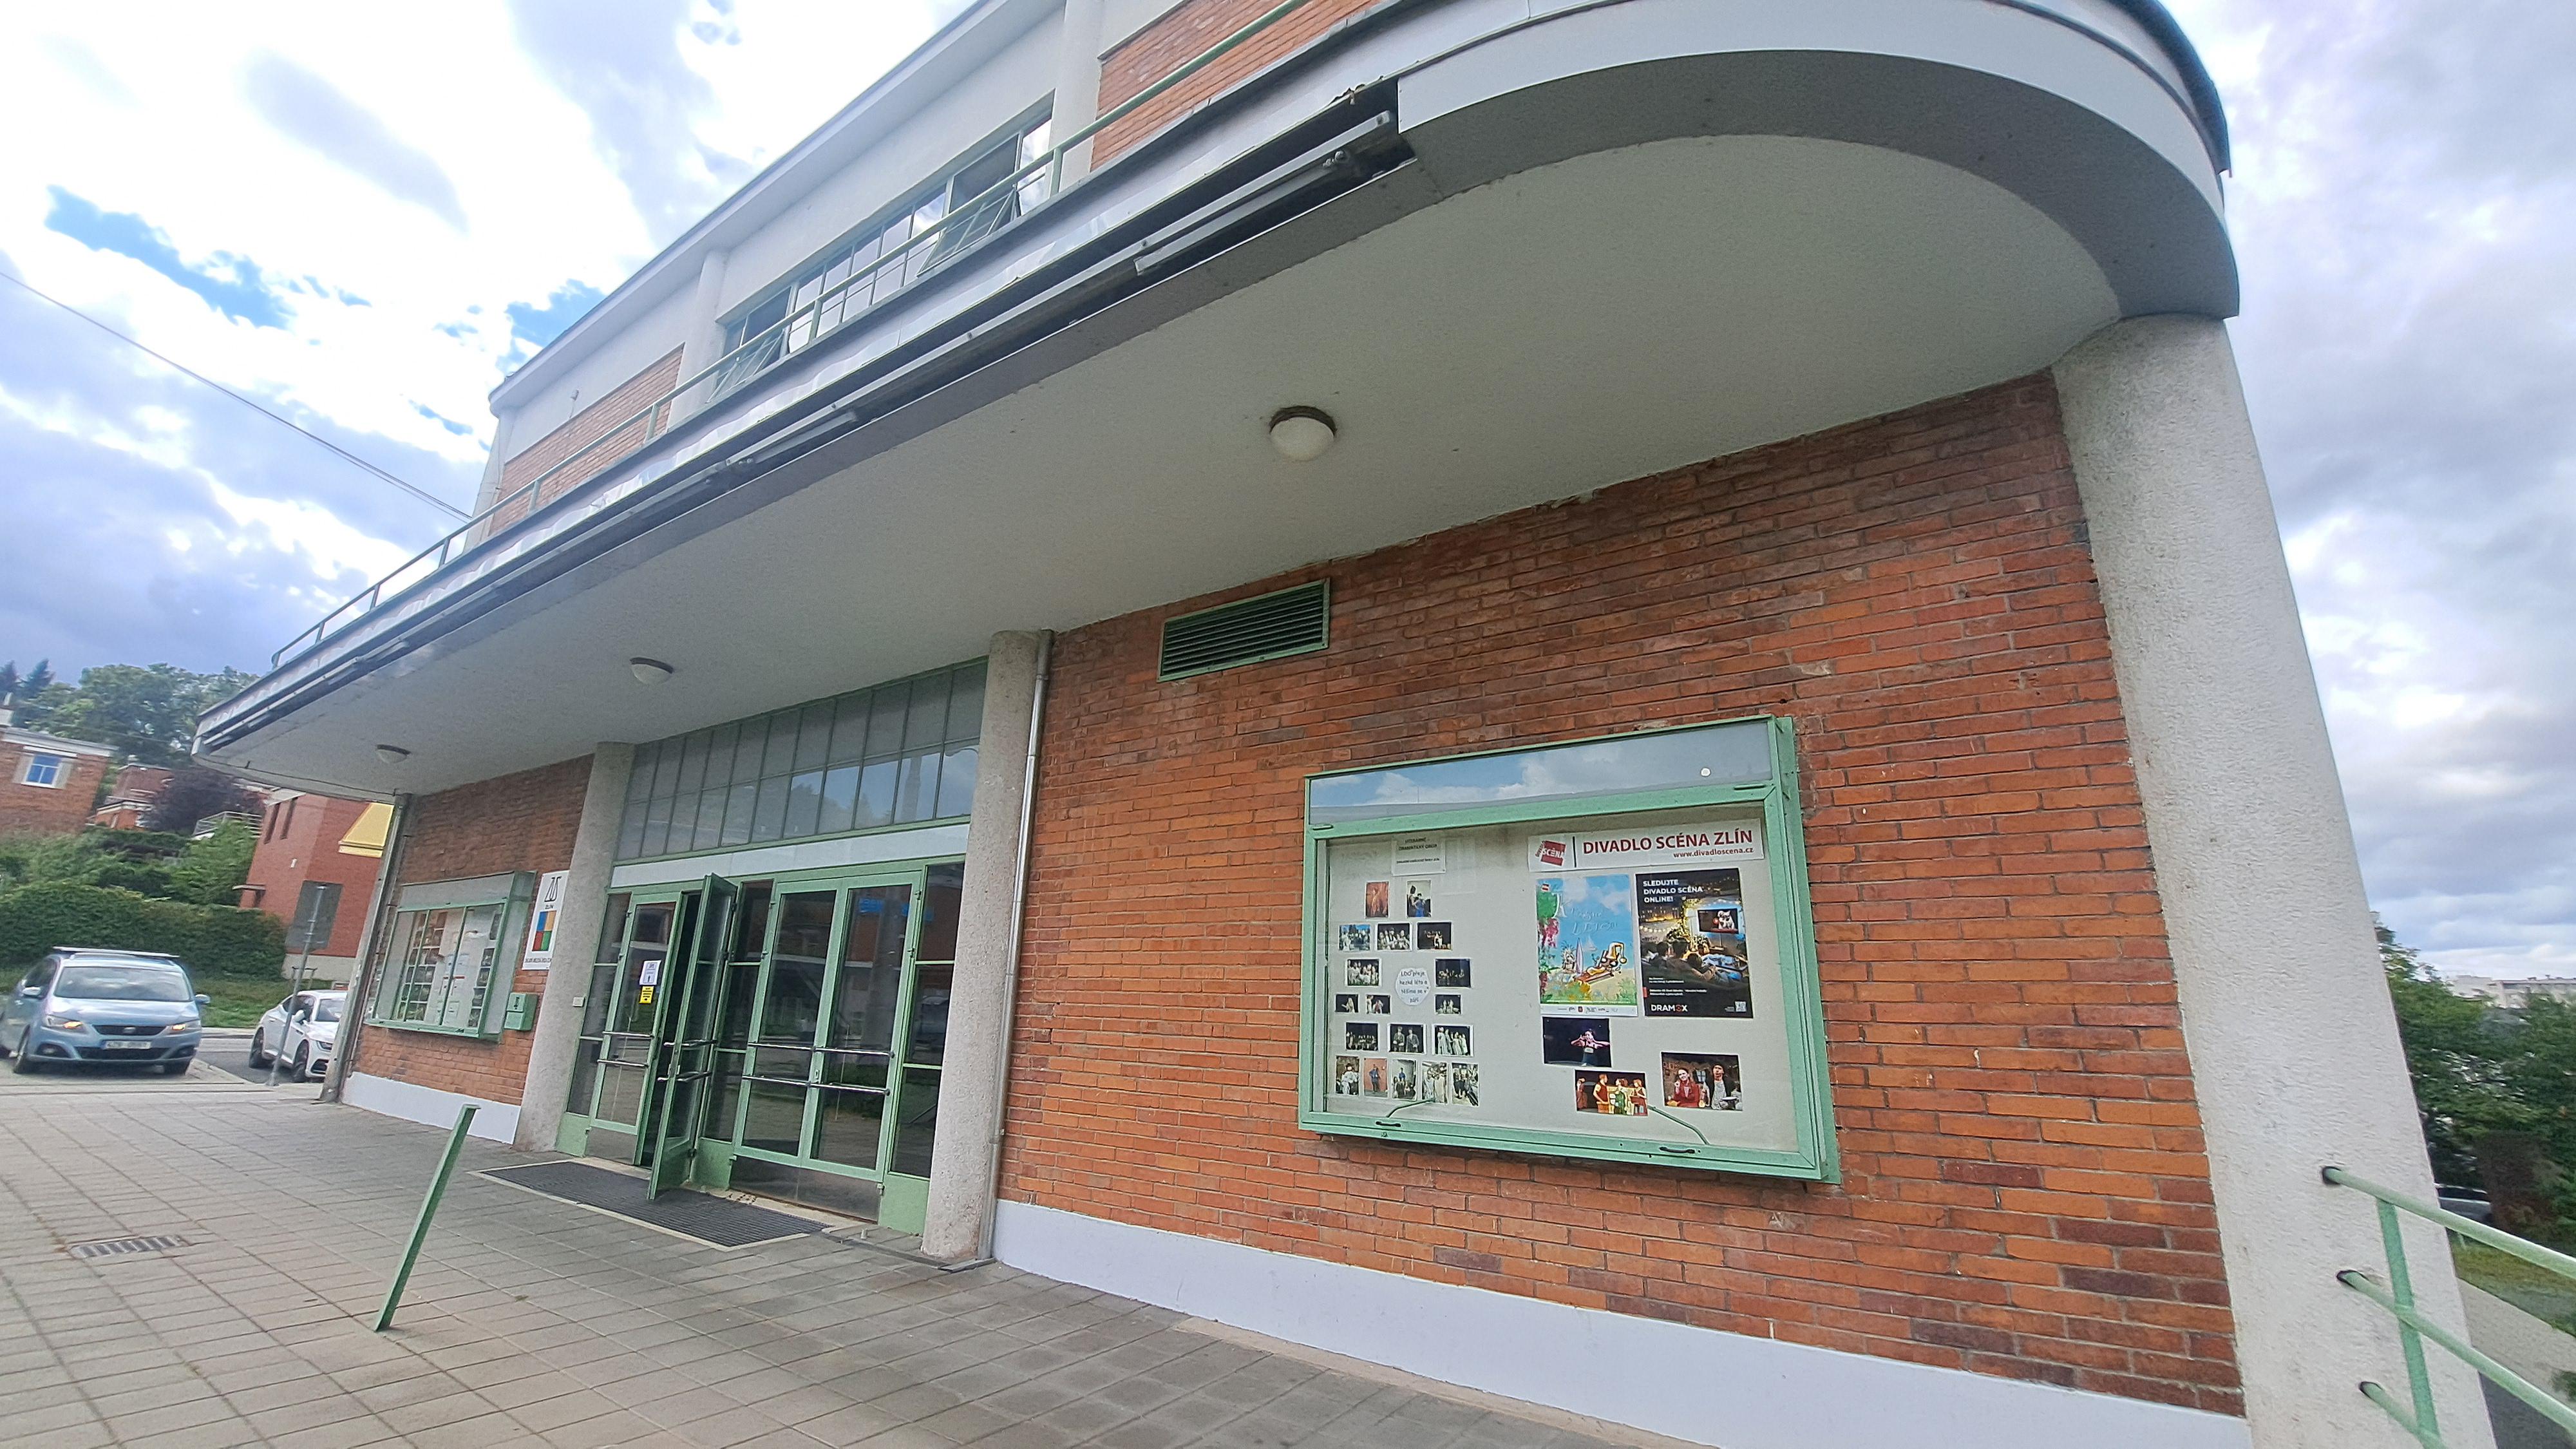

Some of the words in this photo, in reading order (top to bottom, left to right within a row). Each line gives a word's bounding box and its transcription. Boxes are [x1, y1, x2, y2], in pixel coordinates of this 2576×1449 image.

[1584, 837, 1652, 854] DIVADLO
[1656, 832, 1710, 849] SCÉNA
[1714, 828, 1752, 845] ZLÍN
[1542, 848, 1565, 858] SCÉNA
[1673, 847, 1754, 858] www.divadloscena.cz
